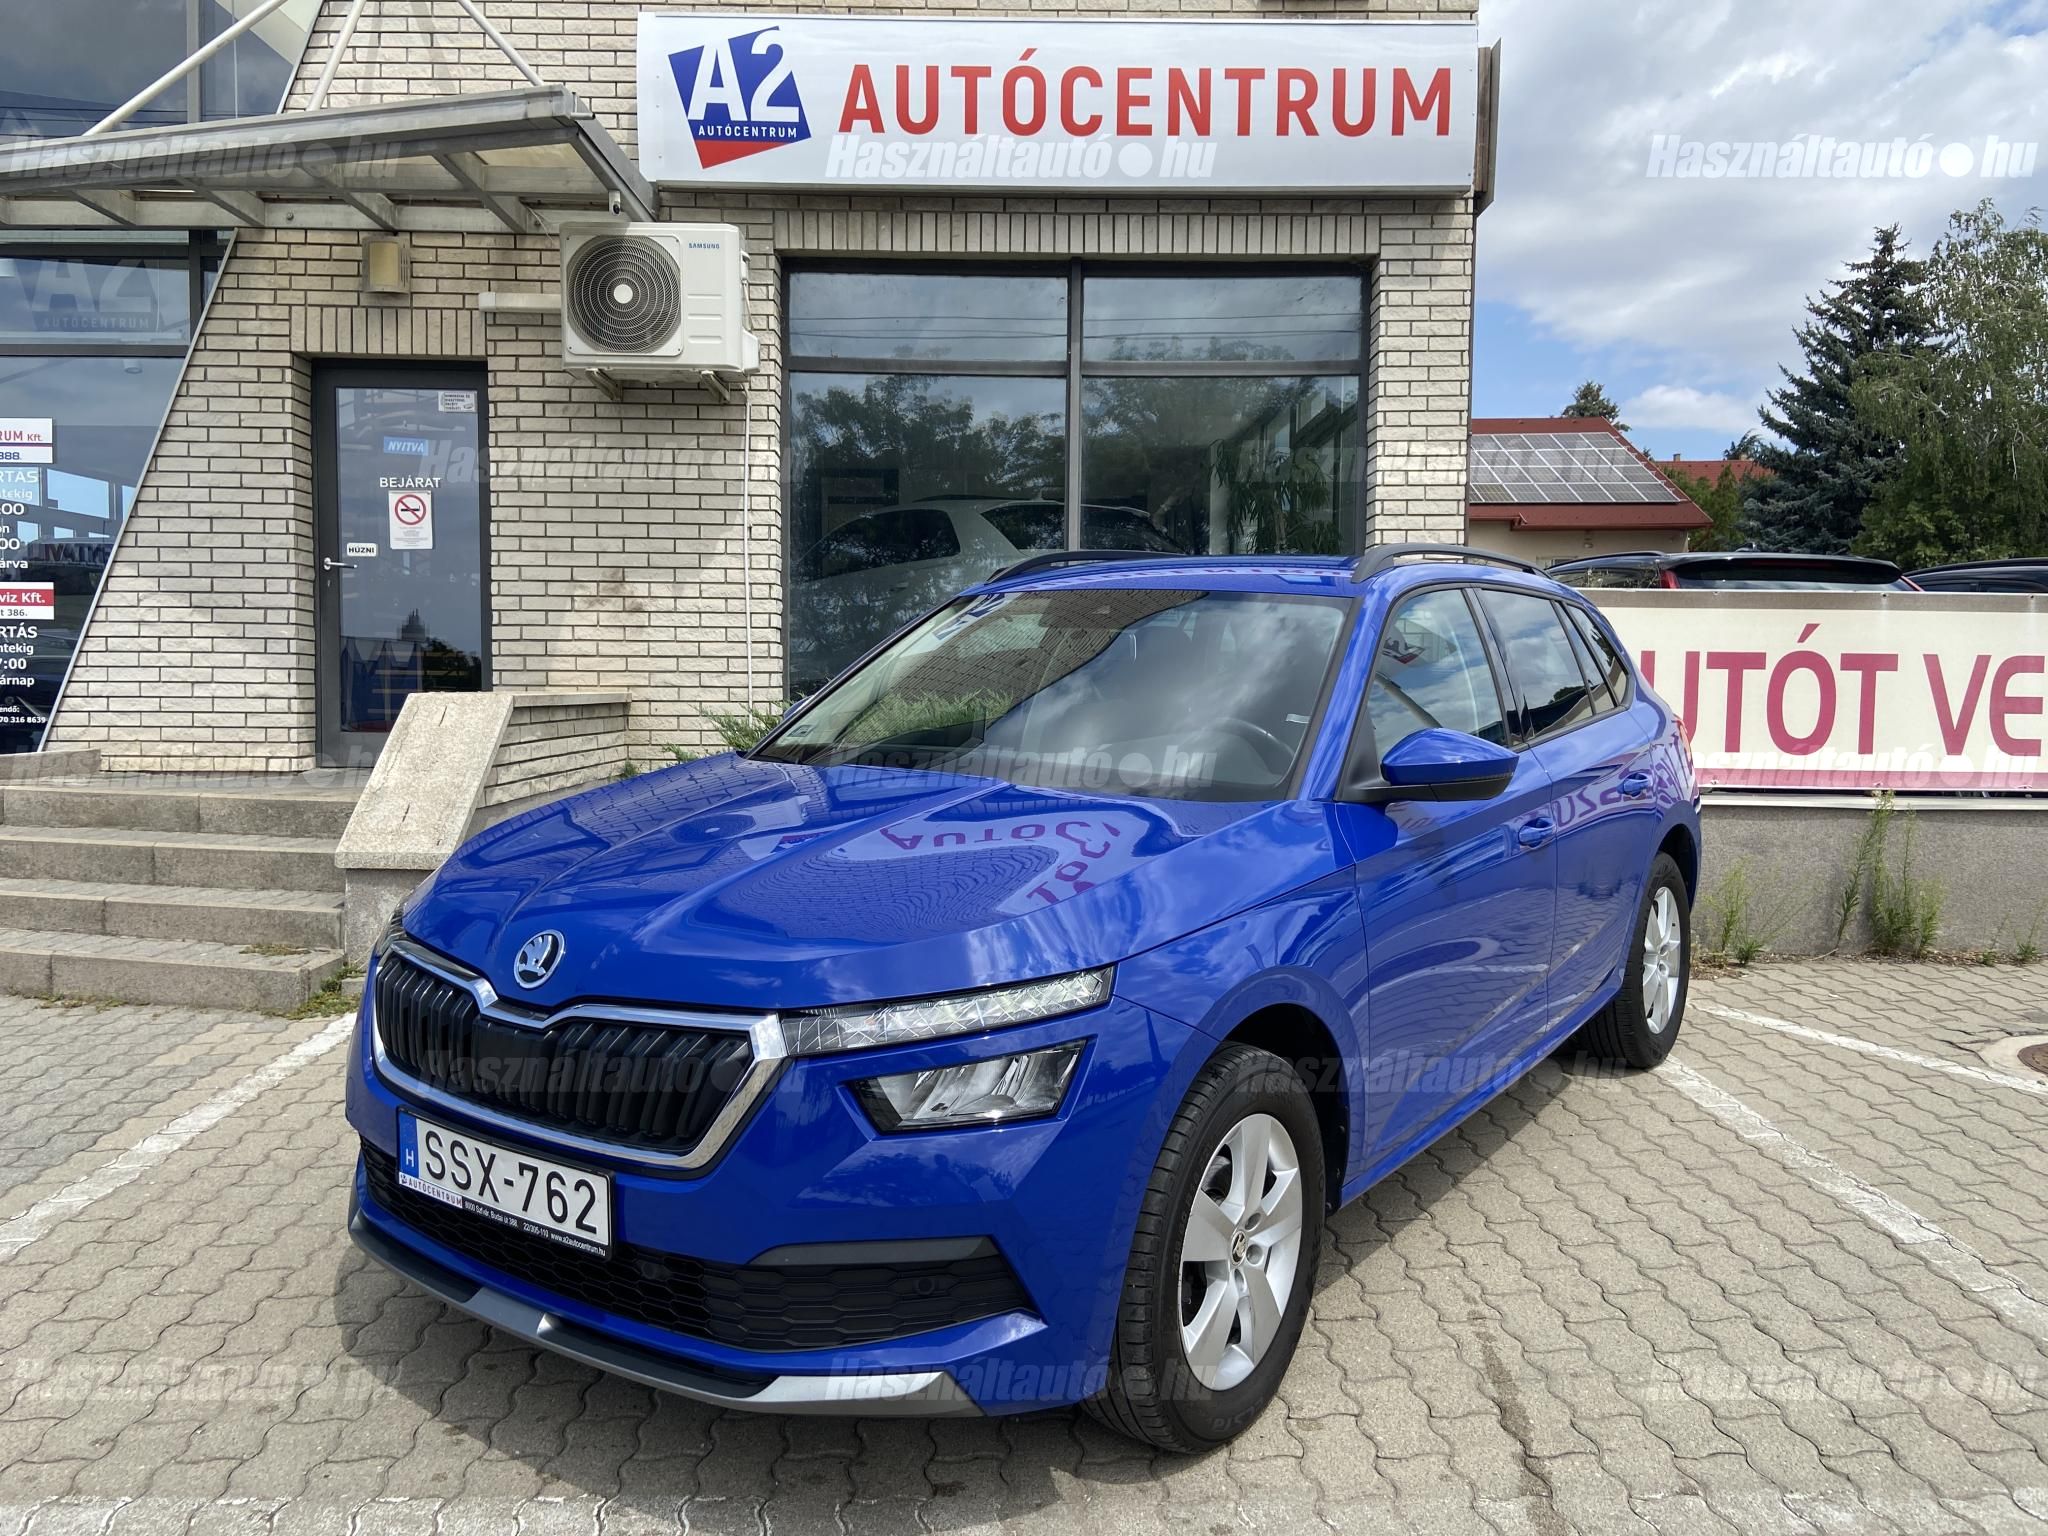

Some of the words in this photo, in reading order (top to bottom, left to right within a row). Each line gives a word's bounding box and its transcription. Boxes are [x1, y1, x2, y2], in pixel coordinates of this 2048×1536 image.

[688, 30, 799, 123] A2
[837, 47, 1451, 138] AUTÓCENTRUM
[697, 122, 798, 139] AUTÓCENTRUM
[688, 242, 720, 250] SAMSUNG
[27, 432, 43, 442] Kft.
[387, 440, 425, 453] NYITVA
[379, 474, 441, 489] BEJÁRAT
[0, 488, 33, 499] tekig
[348, 544, 375, 554] HÚZNI
[21, 591, 46, 604] Kft.
[7, 608, 28, 617] 386.
[27, 716, 46, 724] 8639
[405, 1147, 415, 1168] H
[425, 1130, 598, 1235] SSX-762
